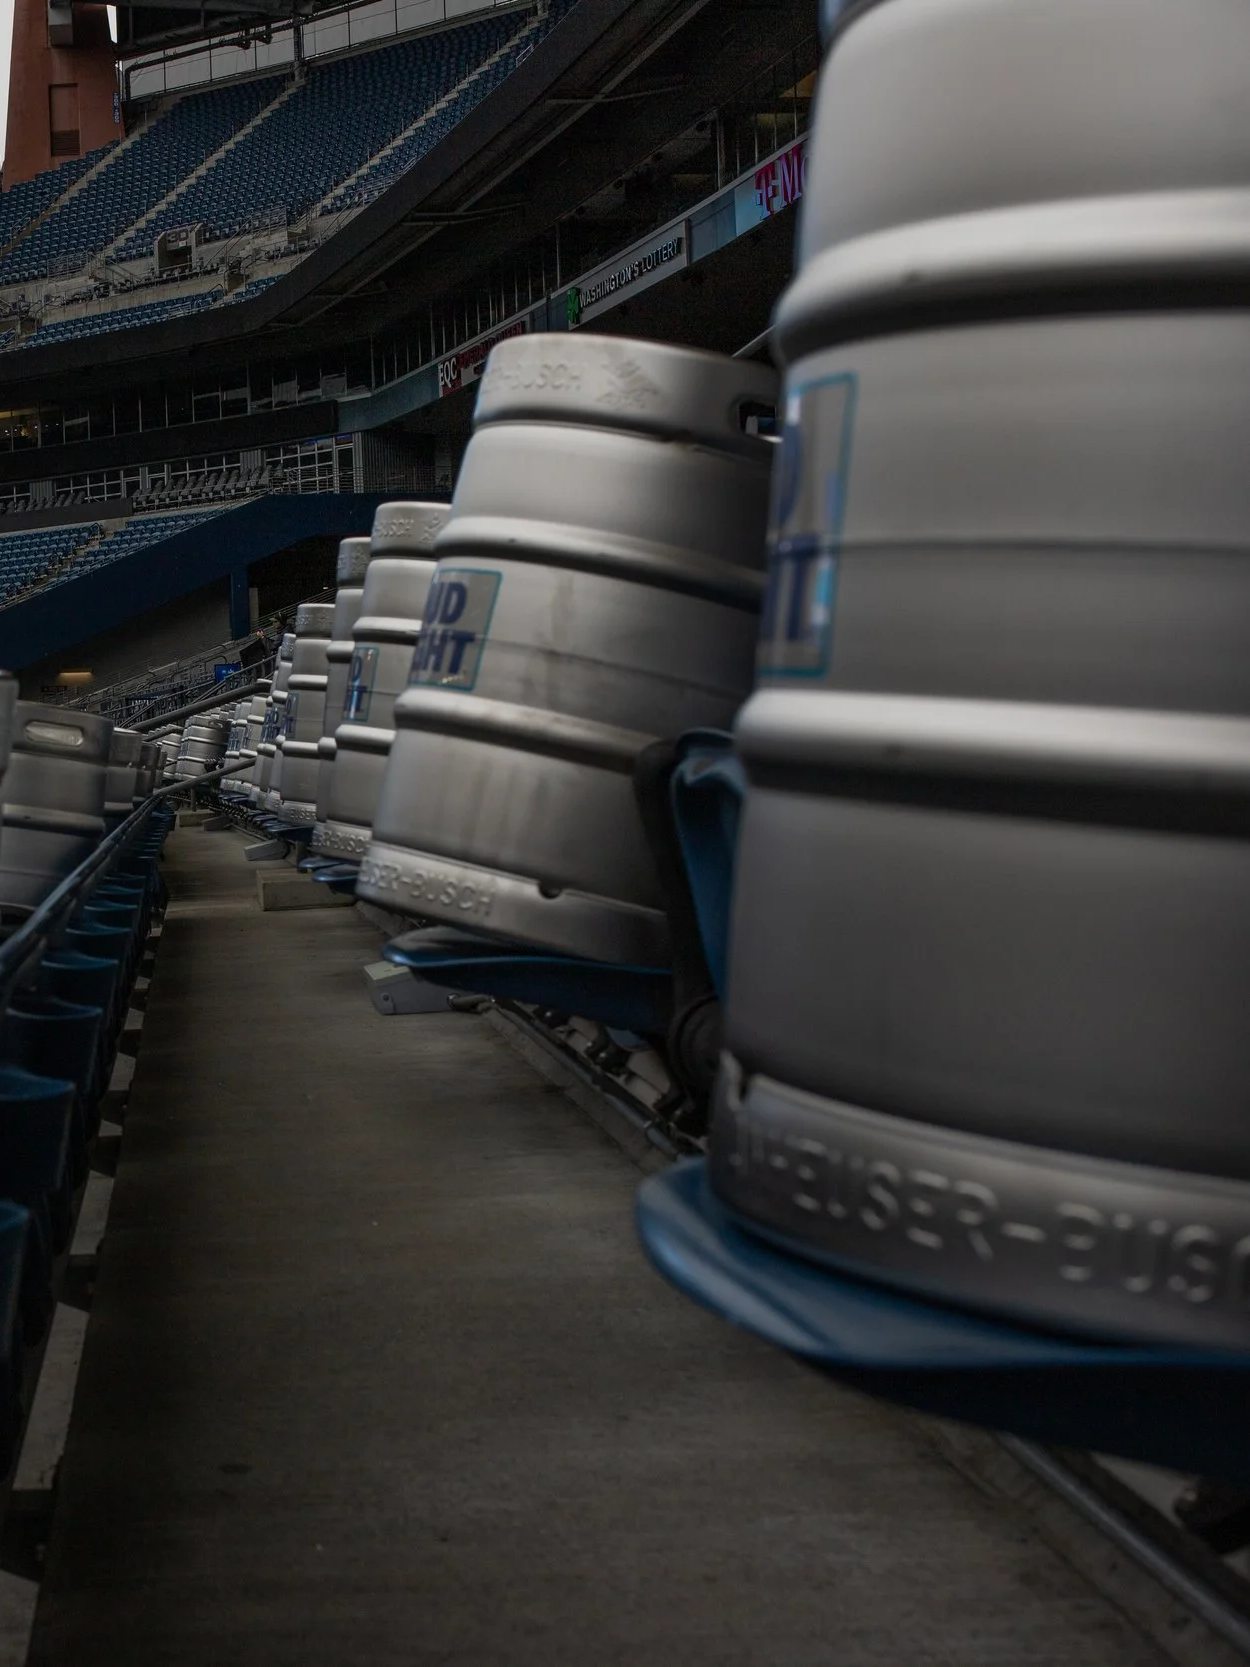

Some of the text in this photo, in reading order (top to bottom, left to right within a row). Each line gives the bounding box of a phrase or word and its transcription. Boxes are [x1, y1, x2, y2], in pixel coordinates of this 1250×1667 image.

[579, 239, 680, 308] WASHINGTON'S LOTTERY
[439, 356, 458, 389] EQC
